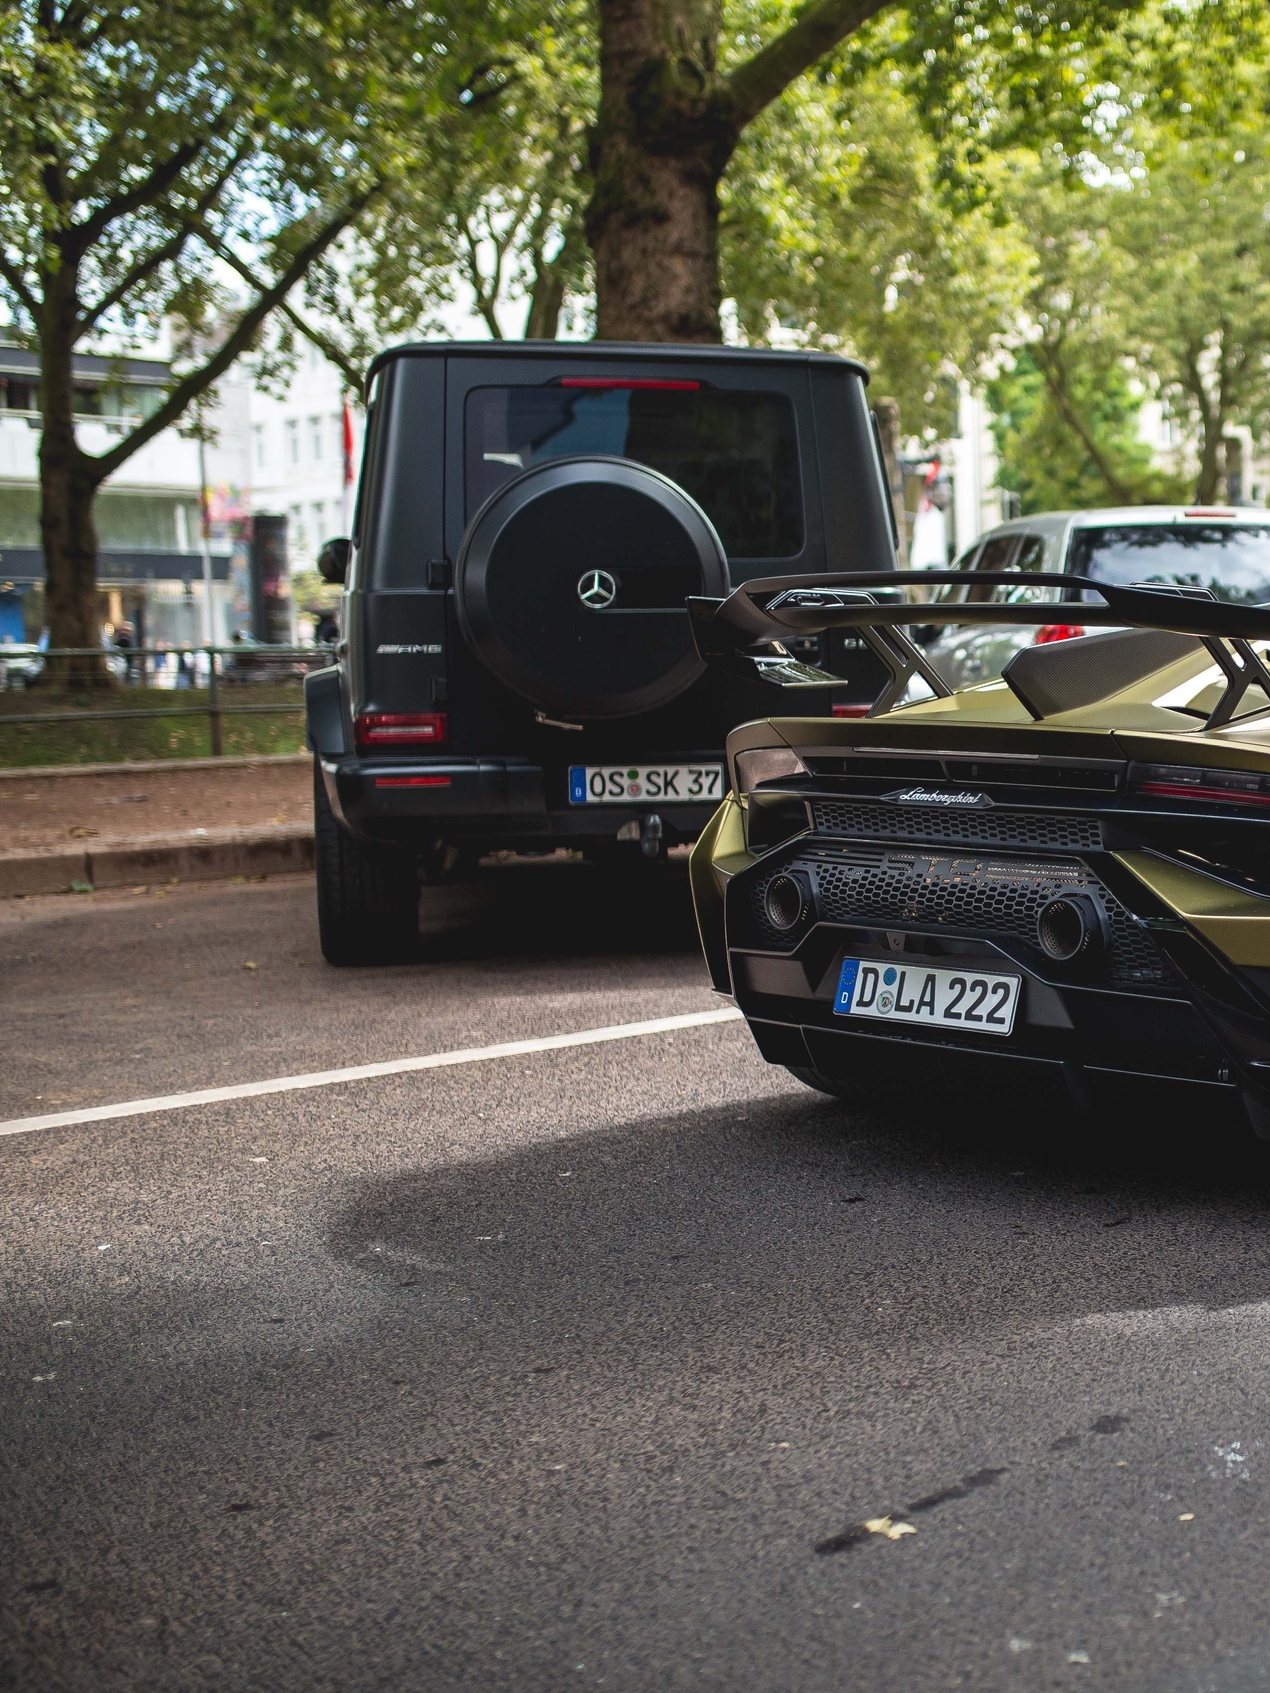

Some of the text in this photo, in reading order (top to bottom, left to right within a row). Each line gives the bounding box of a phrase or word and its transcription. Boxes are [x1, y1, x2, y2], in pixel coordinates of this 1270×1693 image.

[589, 769, 720, 797] OS SK 37
[899, 786, 983, 806] Lamborghini
[841, 992, 849, 1004] D
[855, 967, 1011, 1025] D LA 222
